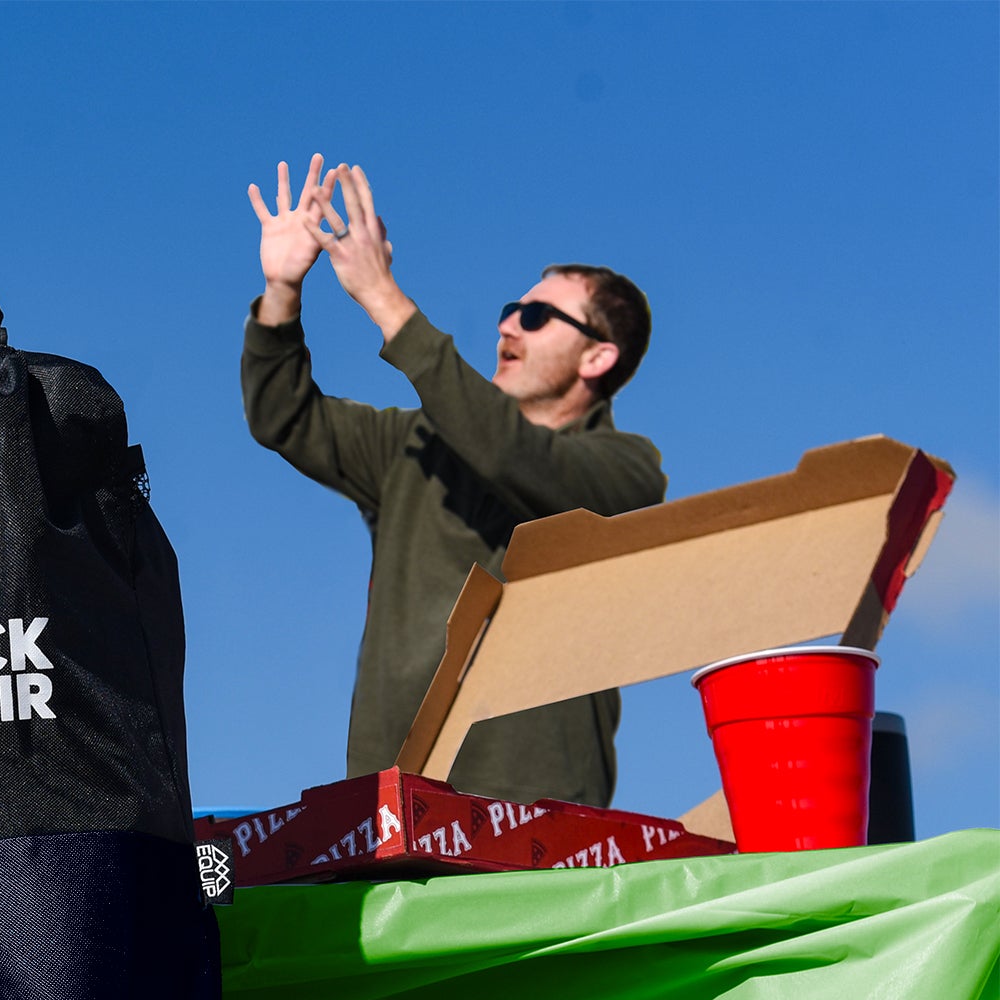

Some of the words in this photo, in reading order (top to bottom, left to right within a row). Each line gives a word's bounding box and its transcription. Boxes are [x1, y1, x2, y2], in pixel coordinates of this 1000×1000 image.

[232, 805, 307, 857] PIZ
[487, 801, 550, 837] PIZ
[196, 844, 217, 898] EQUIP
